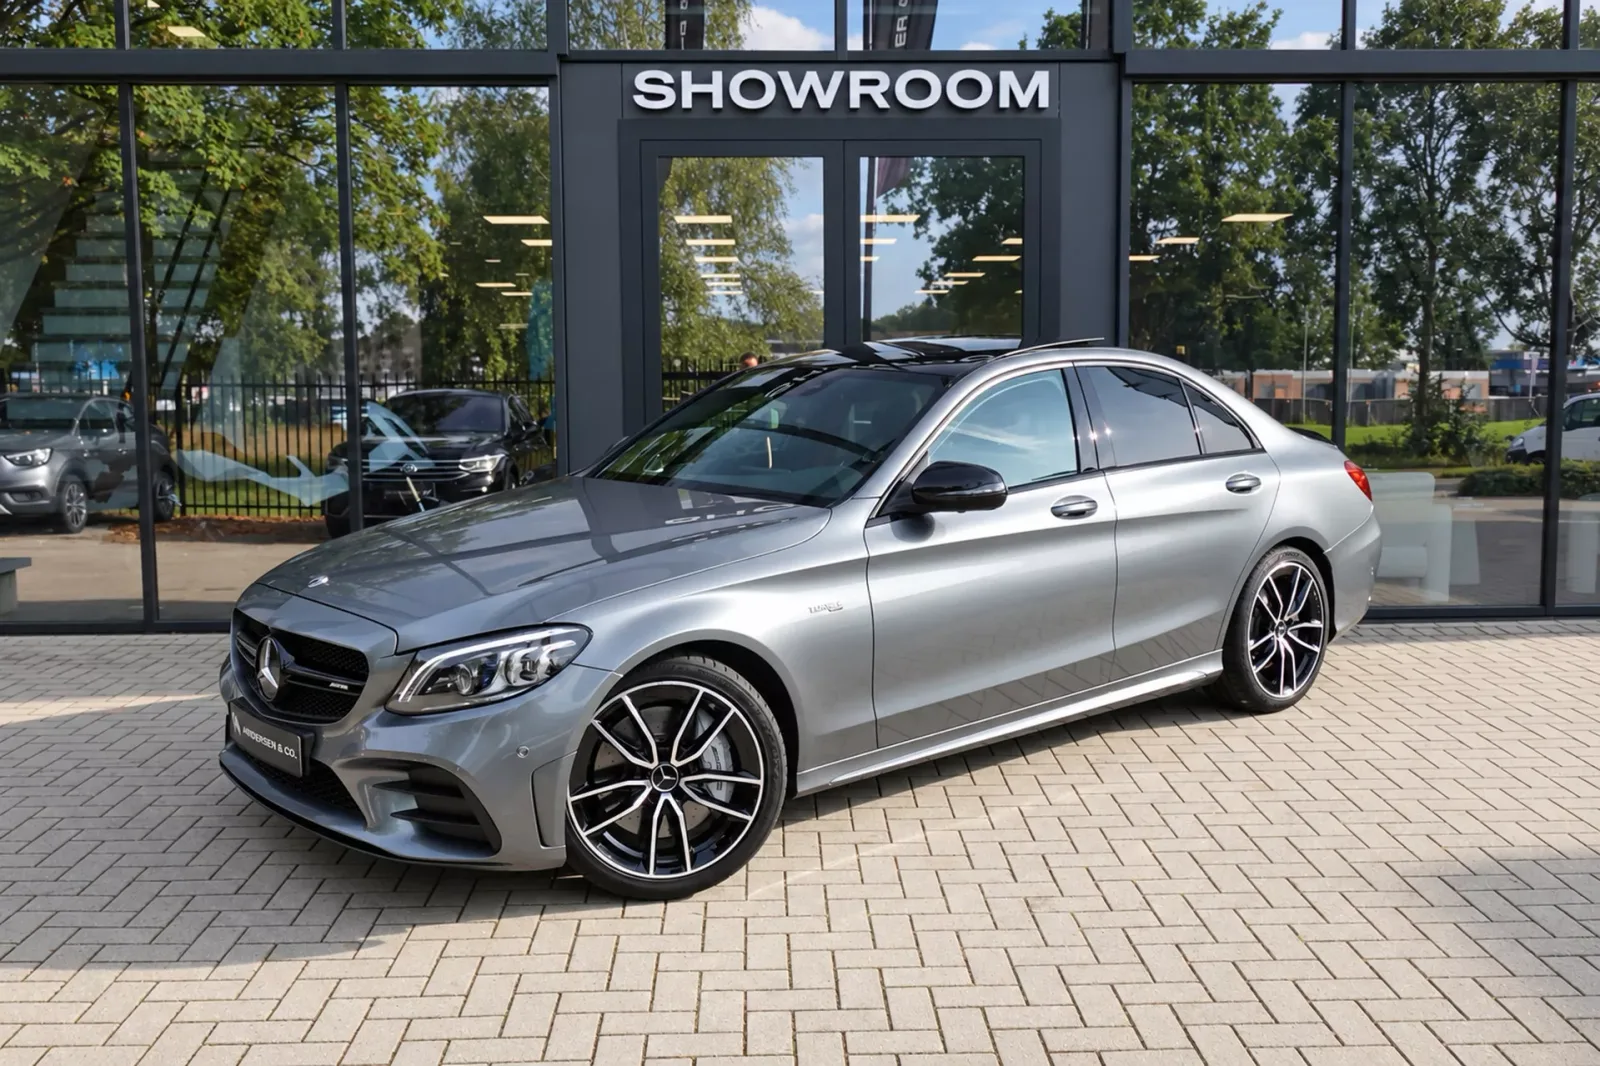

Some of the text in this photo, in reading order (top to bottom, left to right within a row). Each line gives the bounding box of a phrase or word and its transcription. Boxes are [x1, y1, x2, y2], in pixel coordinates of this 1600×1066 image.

[632, 69, 1050, 109] SHOWROOM
[277, 743, 284, 754] &
[283, 746, 298, 760] CO.
